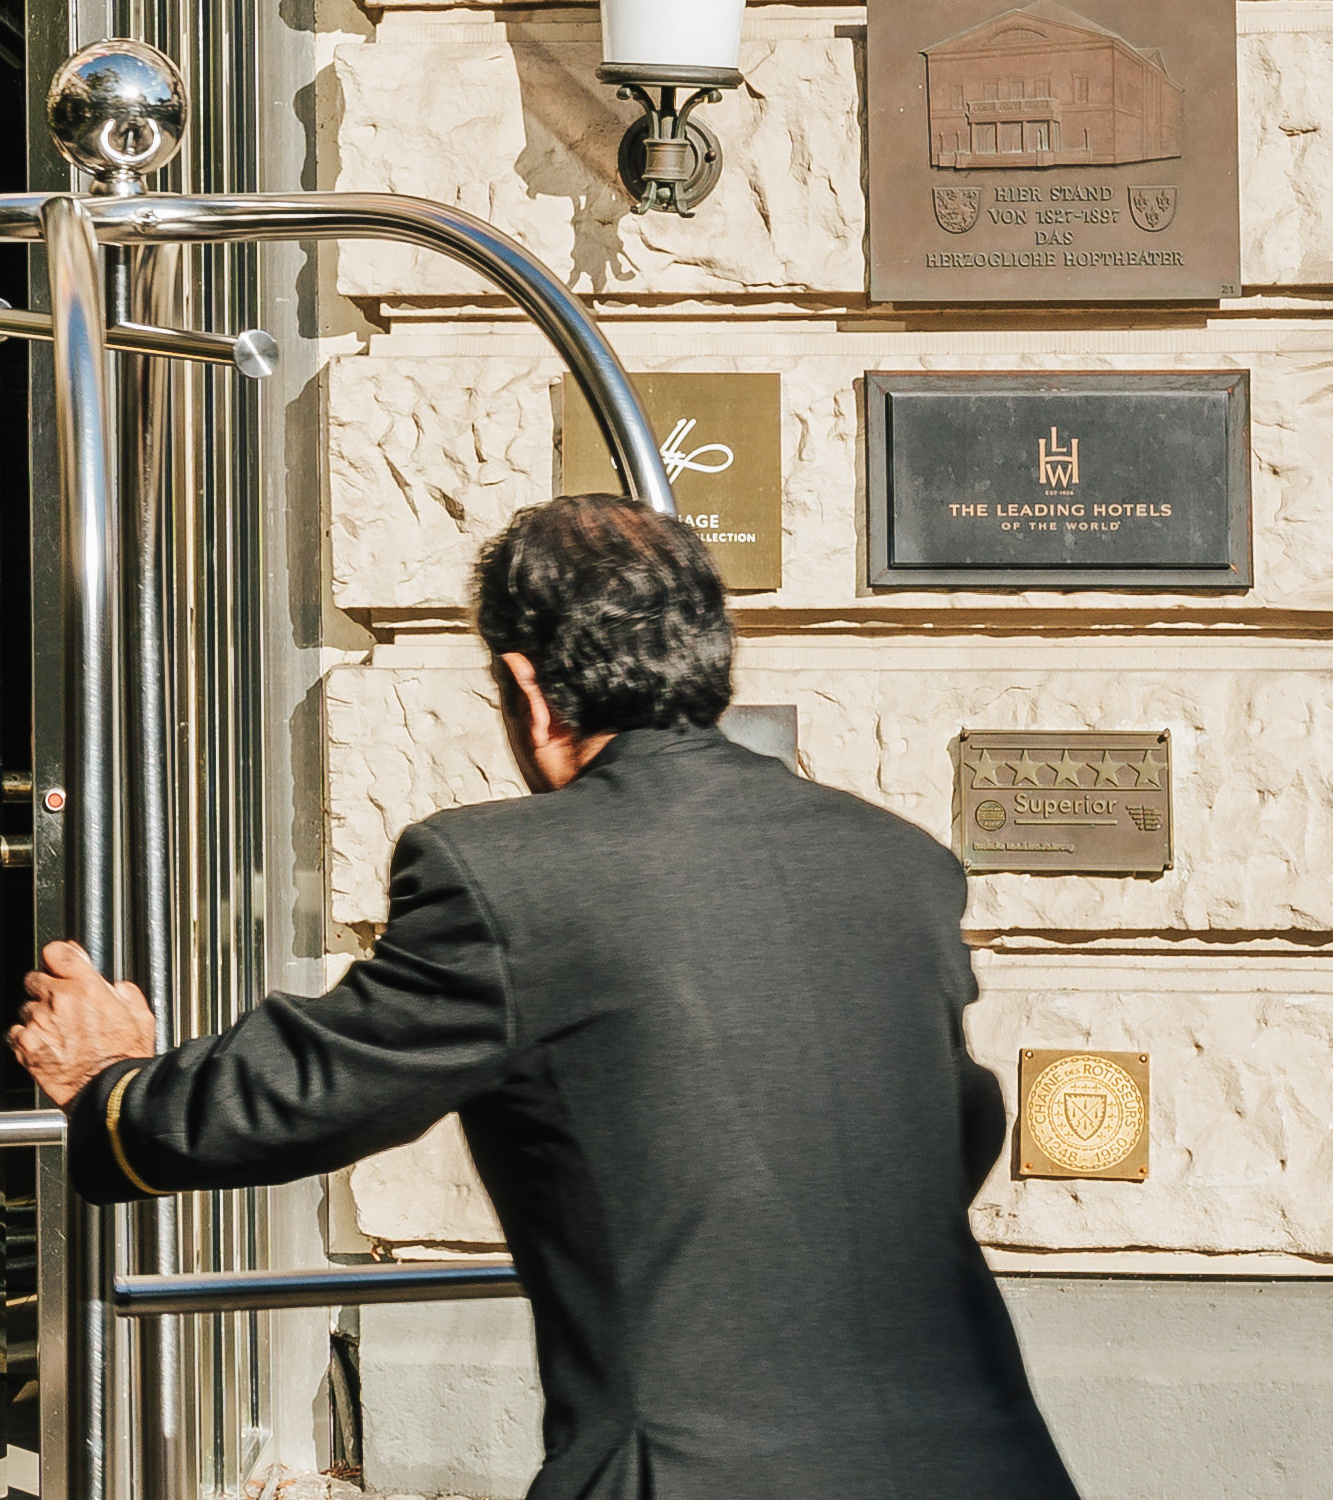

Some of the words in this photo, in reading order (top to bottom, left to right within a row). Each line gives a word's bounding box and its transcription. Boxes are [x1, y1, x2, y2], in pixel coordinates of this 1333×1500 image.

[994, 186, 1043, 202] HIER
[1050, 186, 1115, 202] STAND
[987, 209, 1028, 224] VON
[1035, 231, 1074, 246] DAS
[926, 252, 1057, 268] HERZOGLICHE
[1064, 250, 1185, 267] HOFTHEATER
[949, 503, 988, 517] THE
[996, 503, 1085, 517] LEADING
[1093, 503, 1173, 517] HOTELS
[1001, 521, 1021, 531] OF
[1028, 521, 1058, 531] THE
[696, 532, 756, 543] LLECTION
[1014, 792, 1118, 819] Superior
[1083, 1063, 1137, 1129] ROTISSEURS
[1044, 1135, 1079, 1162] 1248
[1094, 1136, 1128, 1163] 1950
